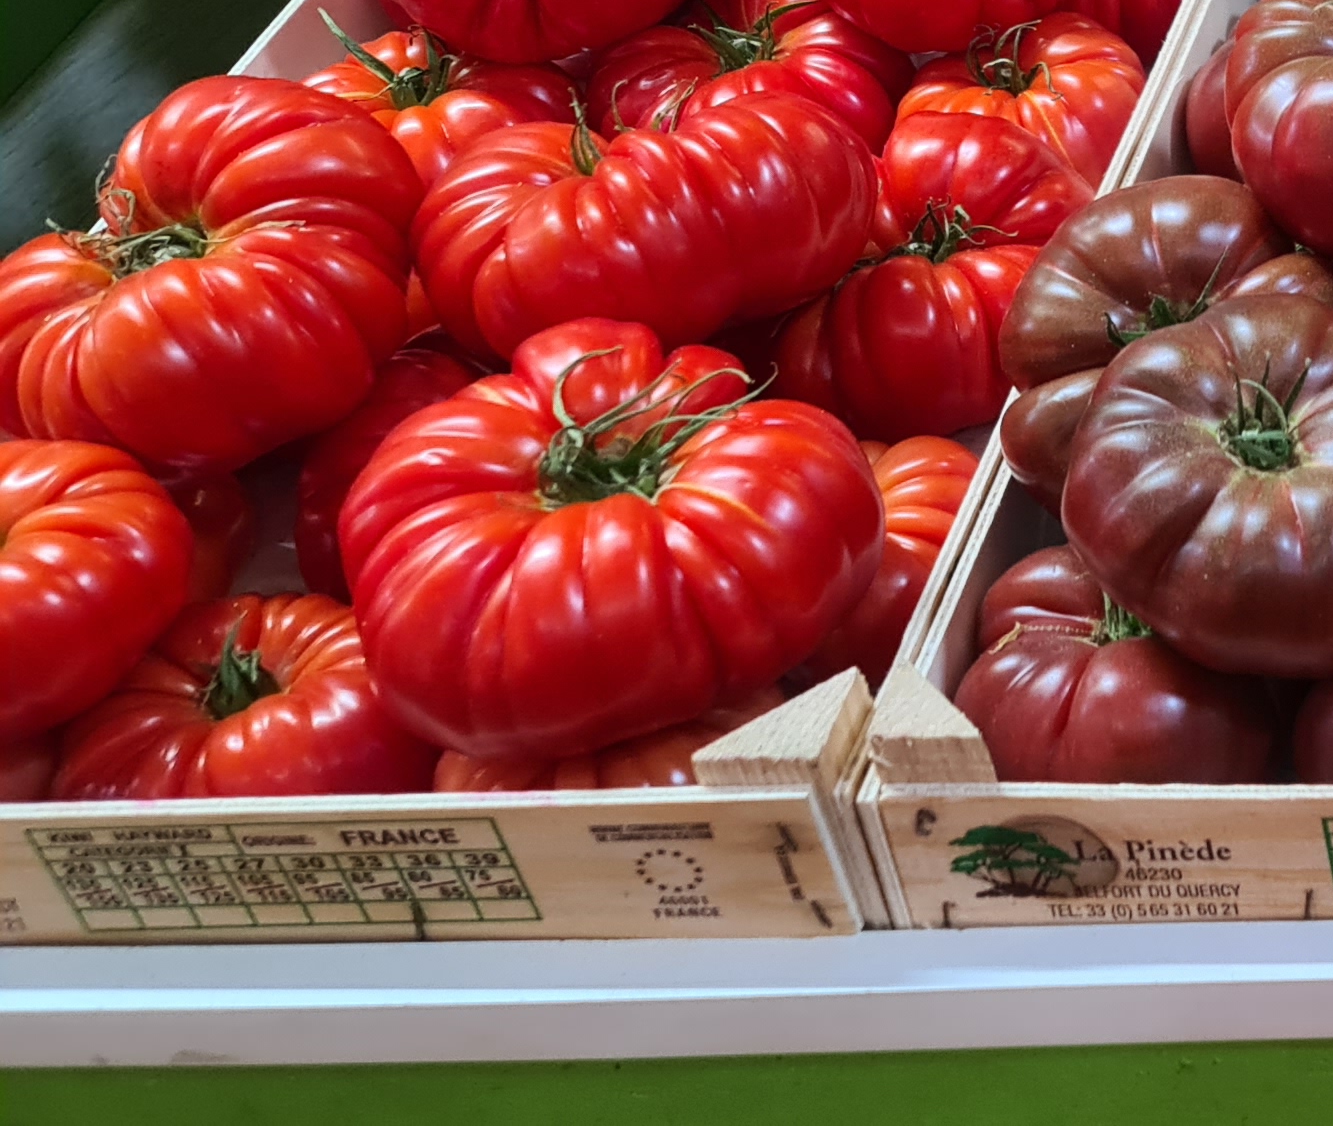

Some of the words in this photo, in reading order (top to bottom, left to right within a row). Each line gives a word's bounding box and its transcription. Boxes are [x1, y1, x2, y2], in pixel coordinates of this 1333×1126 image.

[340, 828, 460, 846] FRANCE
[1073, 840, 1113, 861] La
[1124, 839, 1231, 861] Pinède
[1149, 885, 1172, 899] DU
[1178, 884, 1240, 898] QUERCY
